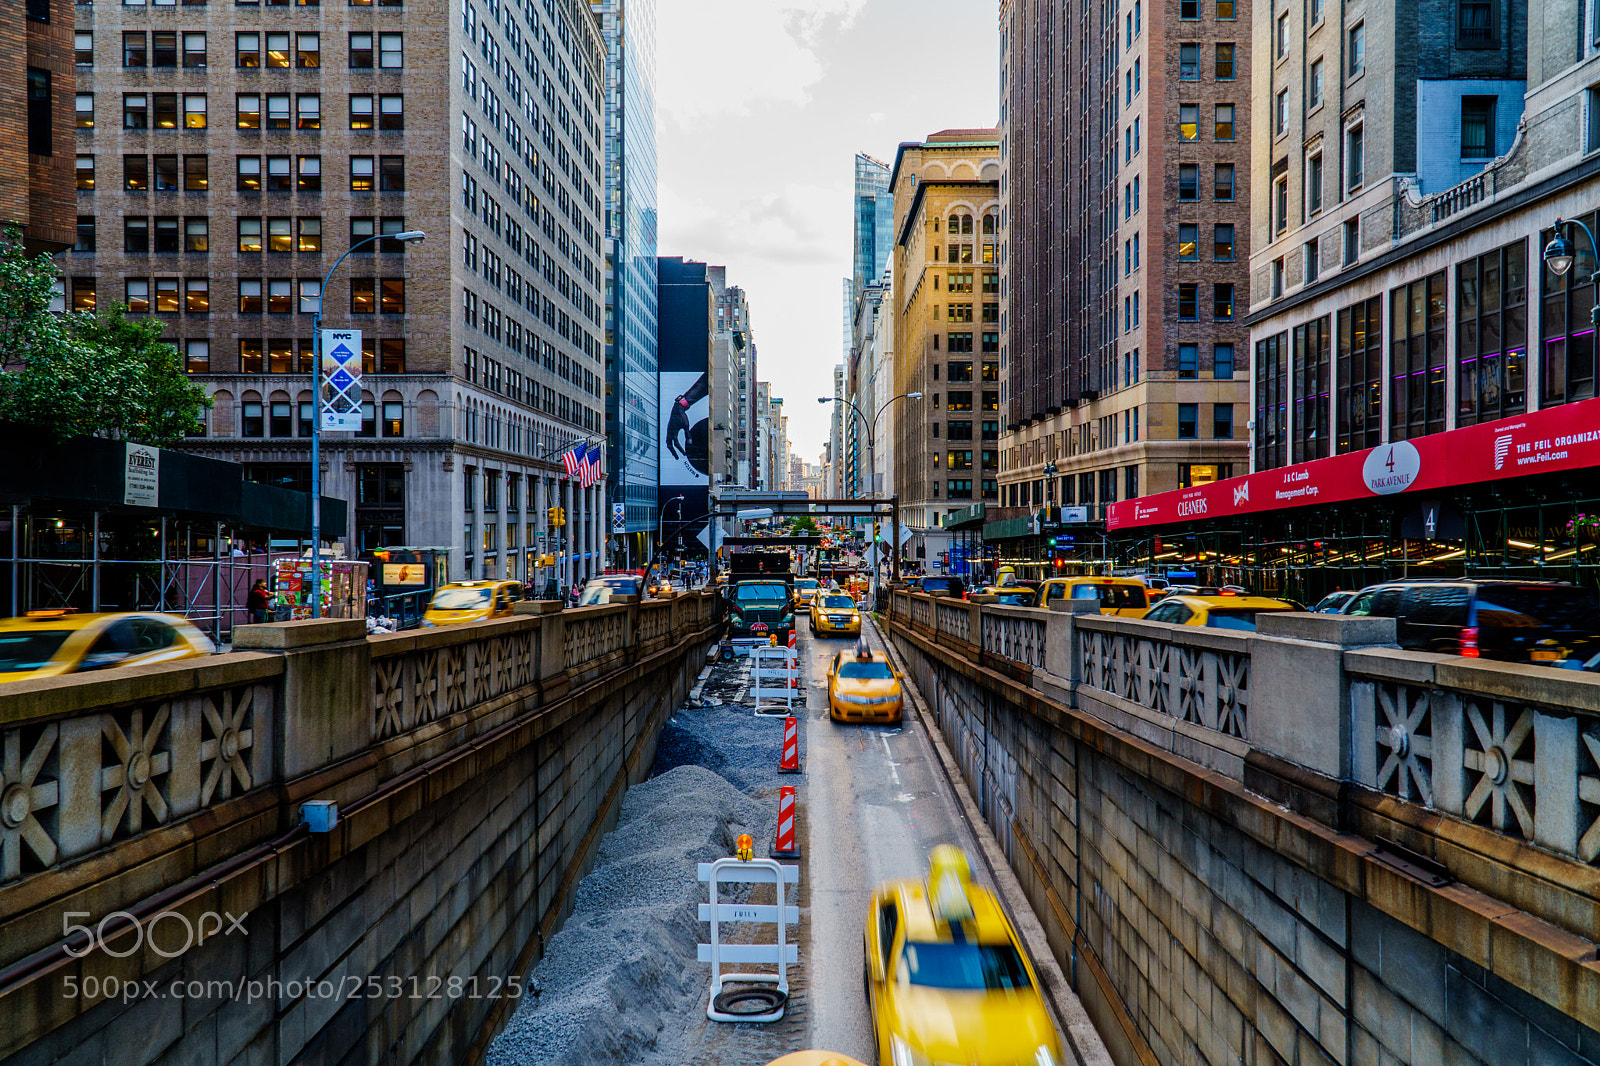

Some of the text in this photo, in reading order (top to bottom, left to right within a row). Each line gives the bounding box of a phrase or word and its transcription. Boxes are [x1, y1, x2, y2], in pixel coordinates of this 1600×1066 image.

[1516, 442, 1531, 454] THE
[1534, 438, 1552, 451] FEIL
[128, 453, 155, 469] EVEREST
[1384, 445, 1396, 473] 4
[1517, 450, 1568, 465] www.Feil.com
[1283, 469, 1309, 483] J & C Lamb
[1371, 473, 1411, 489] PARK AVENUE
[1275, 485, 1319, 500] Management Corp.
[1177, 497, 1208, 517] CLEANERS
[1425, 507, 1436, 532] 4
